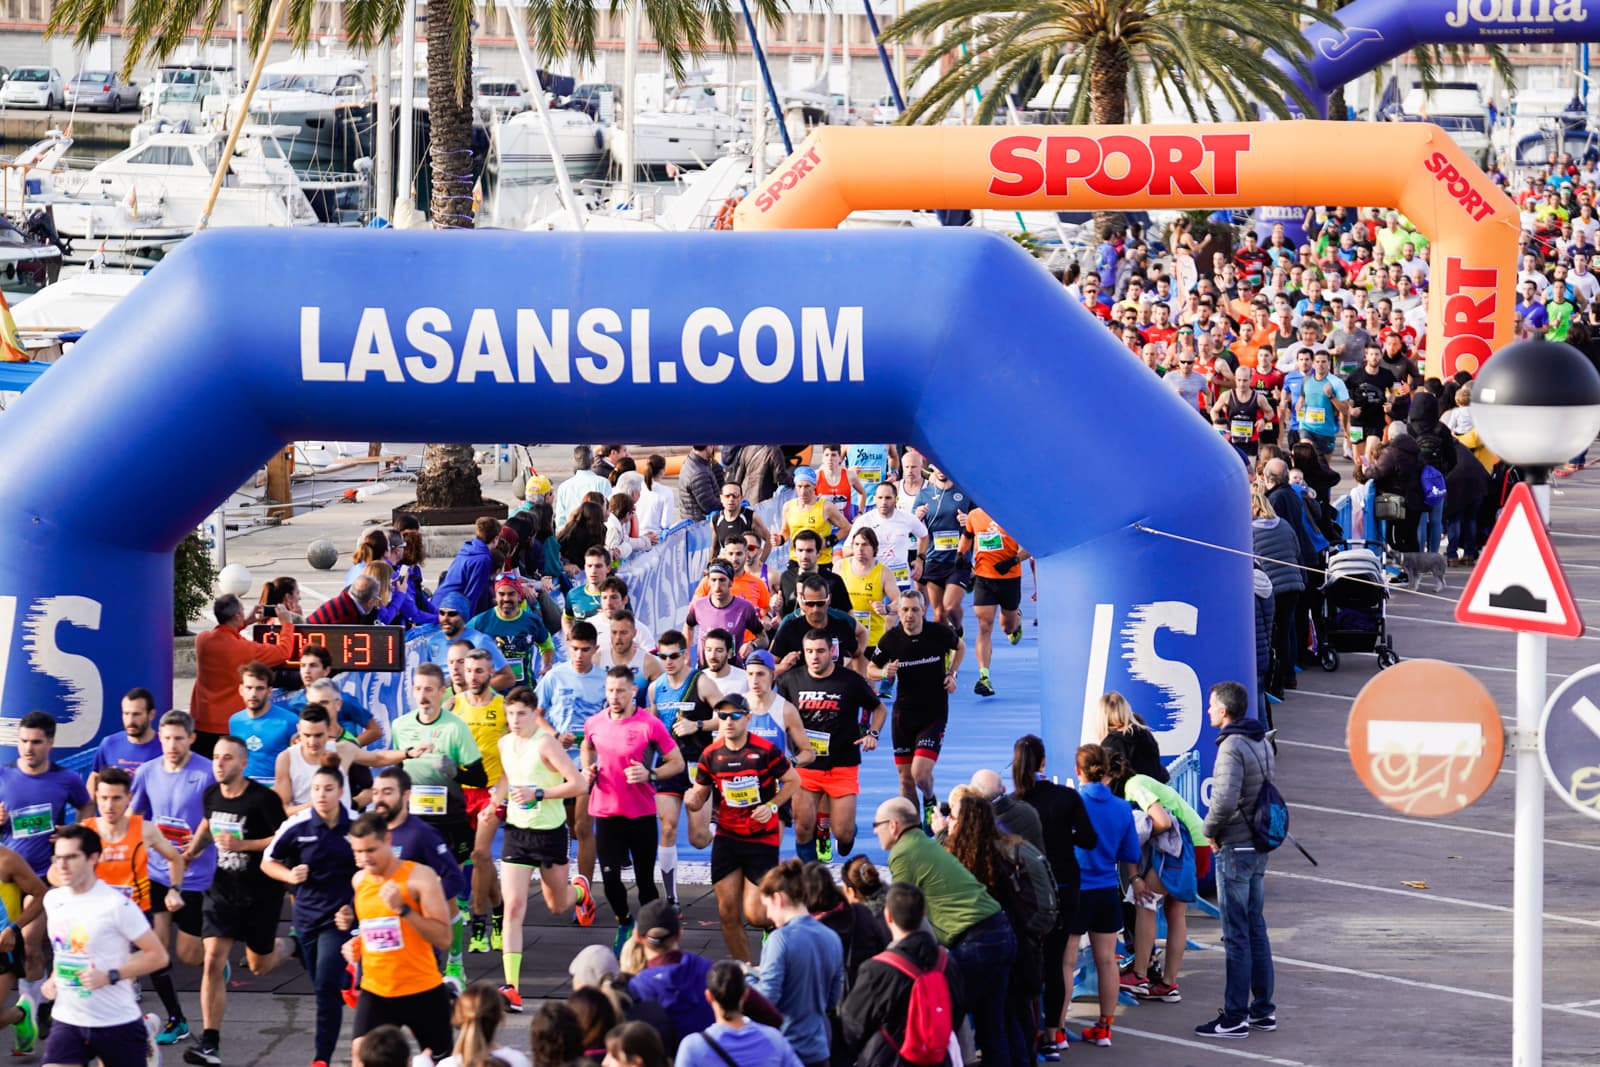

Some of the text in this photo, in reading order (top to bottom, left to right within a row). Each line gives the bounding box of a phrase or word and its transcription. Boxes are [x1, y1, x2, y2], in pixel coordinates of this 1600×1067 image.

[755, 146, 822, 213] SPORT
[988, 134, 1251, 198] SPORT
[1424, 151, 1496, 223] SPORT
[300, 306, 863, 383] LASANSI.COM
[1441, 256, 1498, 379] ORT
[798, 700, 841, 710] TOUR
